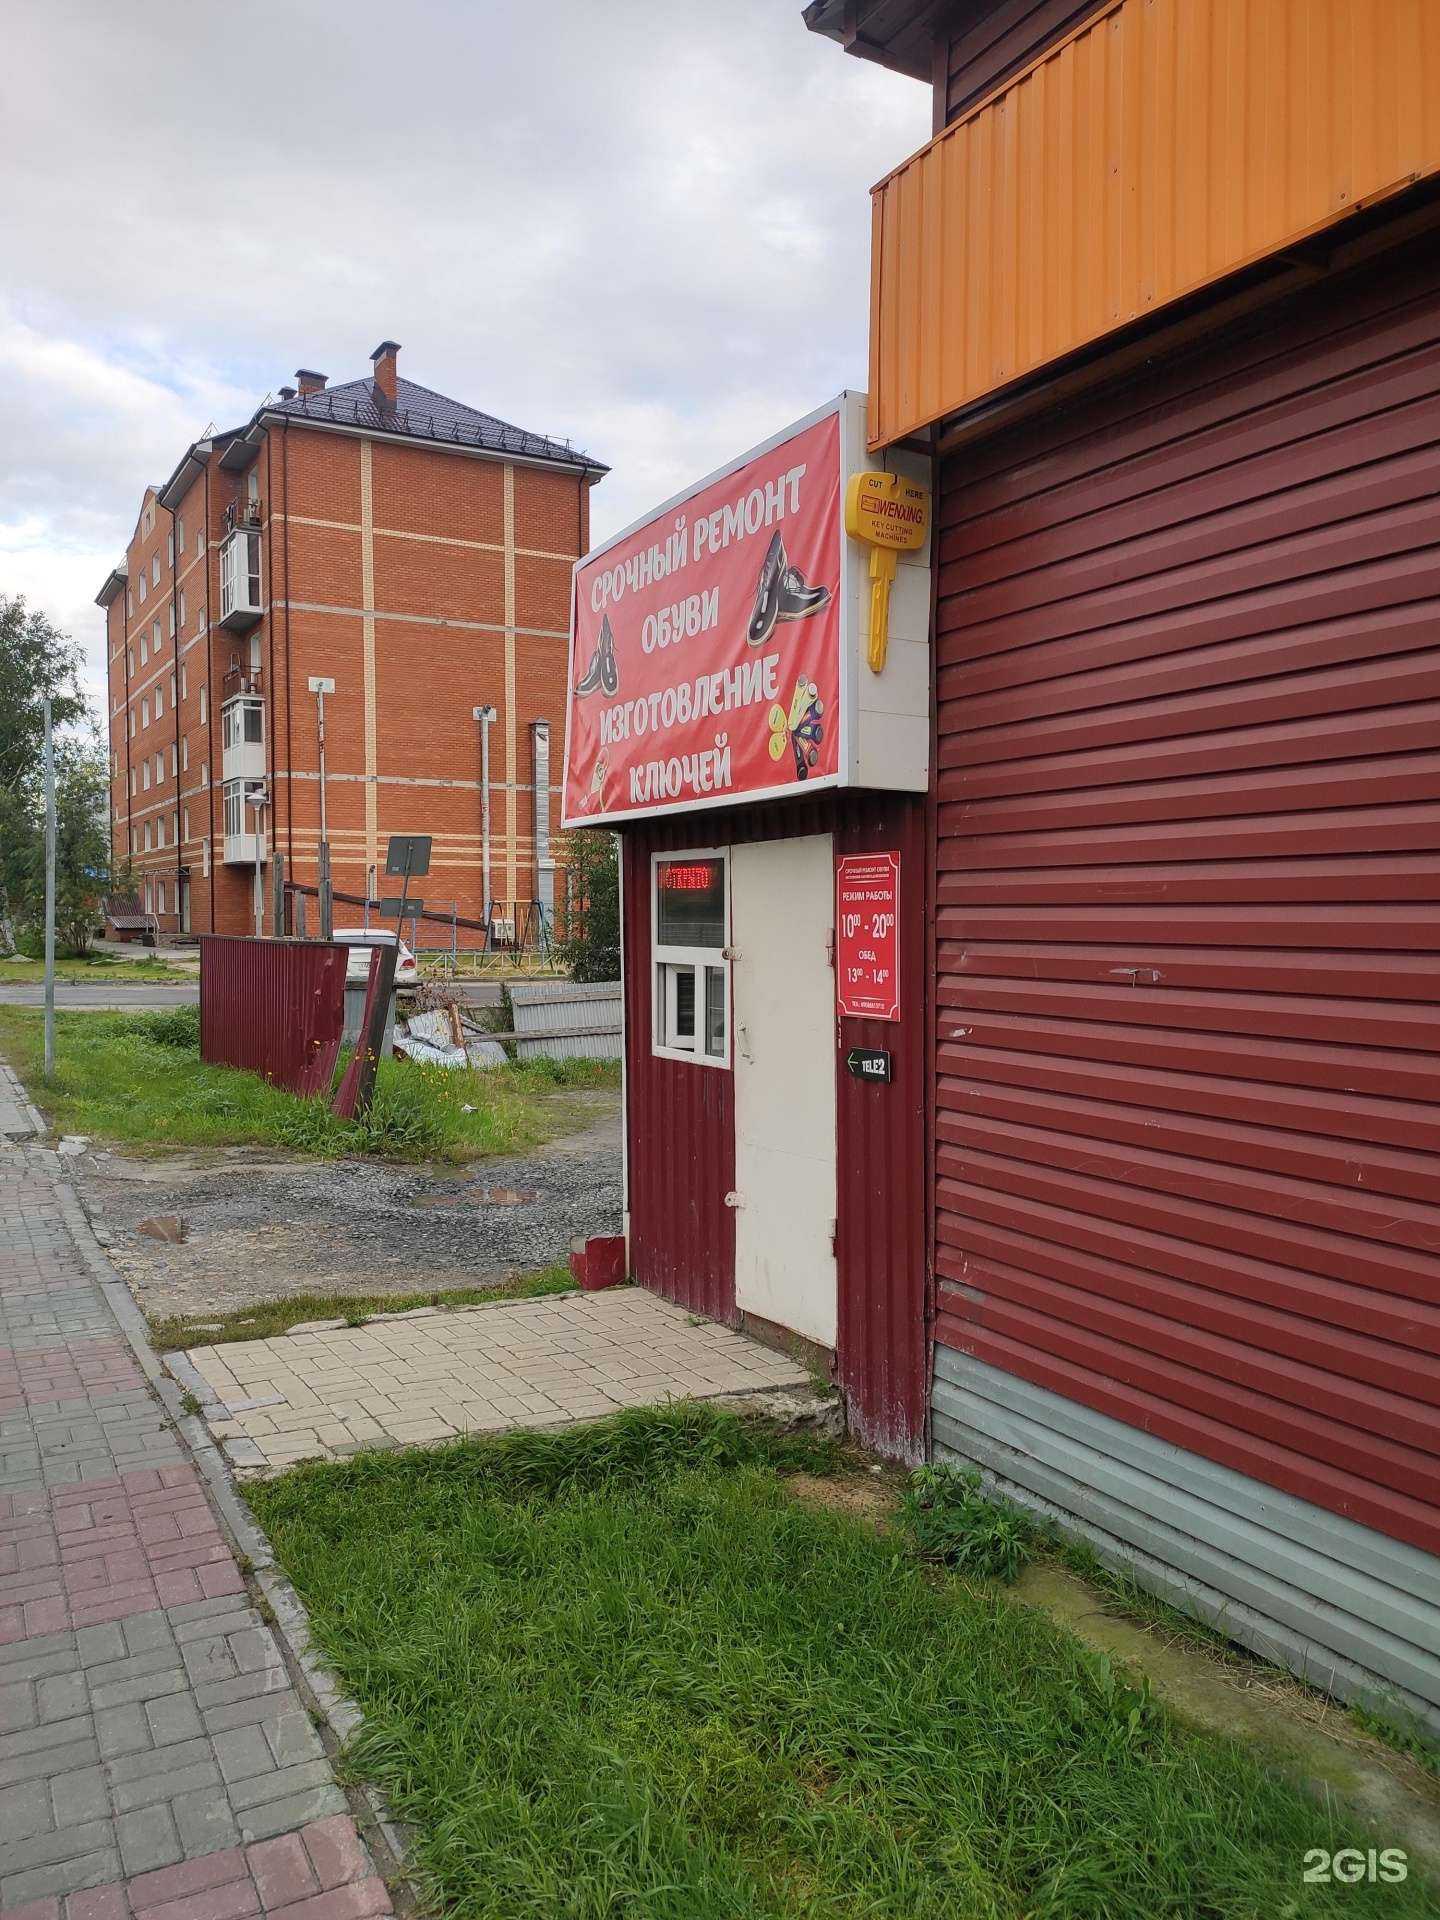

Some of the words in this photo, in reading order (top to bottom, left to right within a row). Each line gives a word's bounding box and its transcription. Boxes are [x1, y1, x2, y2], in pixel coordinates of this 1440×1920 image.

[869, 479, 883, 488] CUT
[905, 488, 924, 499] HERE
[878, 500, 923, 523] WENXING
[872, 520, 884, 529] KEY
[885, 522, 912, 535] CUTTING
[876, 531, 907, 544] MACHINES
[591, 515, 687, 612] СРОЧНЫЙ
[693, 464, 807, 561] РЕМОНТ
[641, 586, 719, 654] ОБУВИ
[600, 653, 780, 746] ИЗГОТОВЛЕНИЕ
[629, 732, 732, 804] КЛЮЧЕЙ
[842, 892, 865, 901] РЕЖИМ
[866, 890, 893, 900] РАБОТЫ
[858, 950, 876, 961] ОБЕД
[861, 1058, 886, 1075] TELE2
